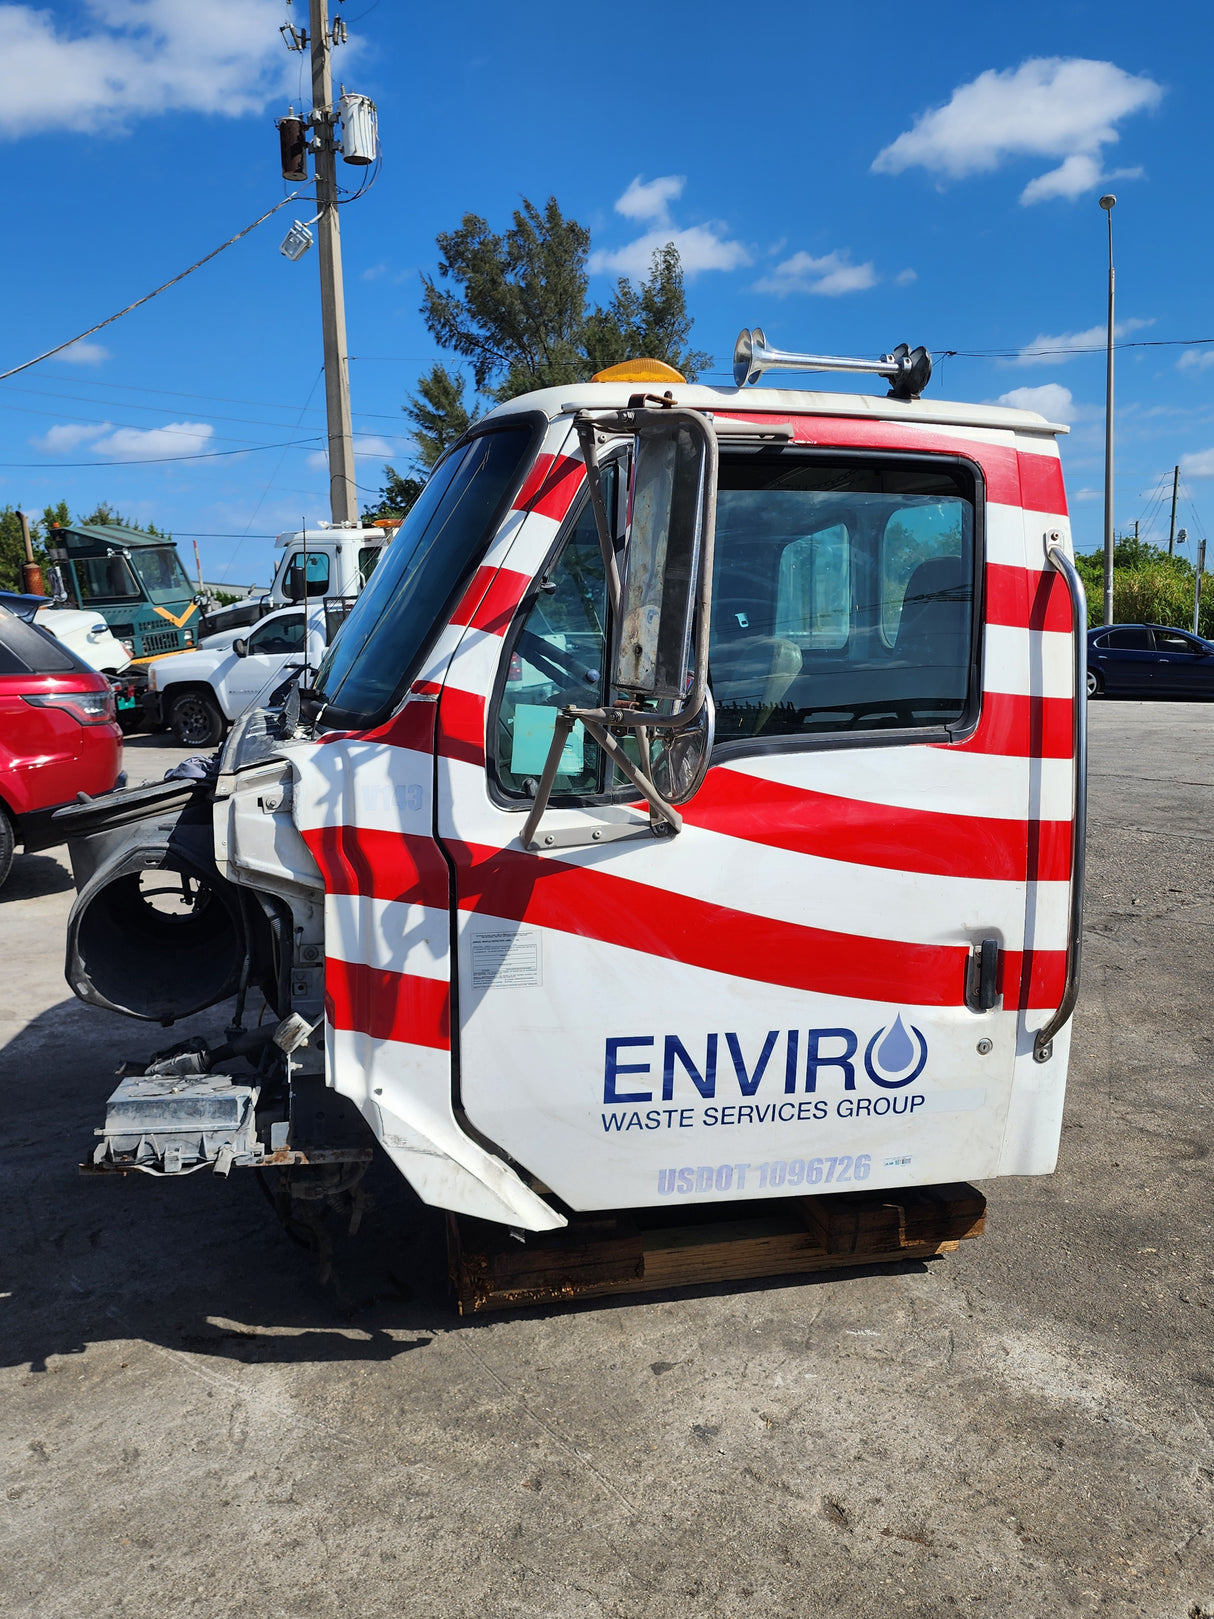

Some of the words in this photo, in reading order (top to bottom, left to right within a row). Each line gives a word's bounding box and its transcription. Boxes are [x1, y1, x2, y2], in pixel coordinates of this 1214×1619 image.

[603, 1023, 928, 1105] ENVIRO
[601, 1108, 695, 1132] WASTE
[702, 1100, 828, 1127] SERVICES
[836, 1094, 926, 1118] GROUP
[657, 1162, 751, 1196] USDOT
[758, 1153, 871, 1189] 1096726
